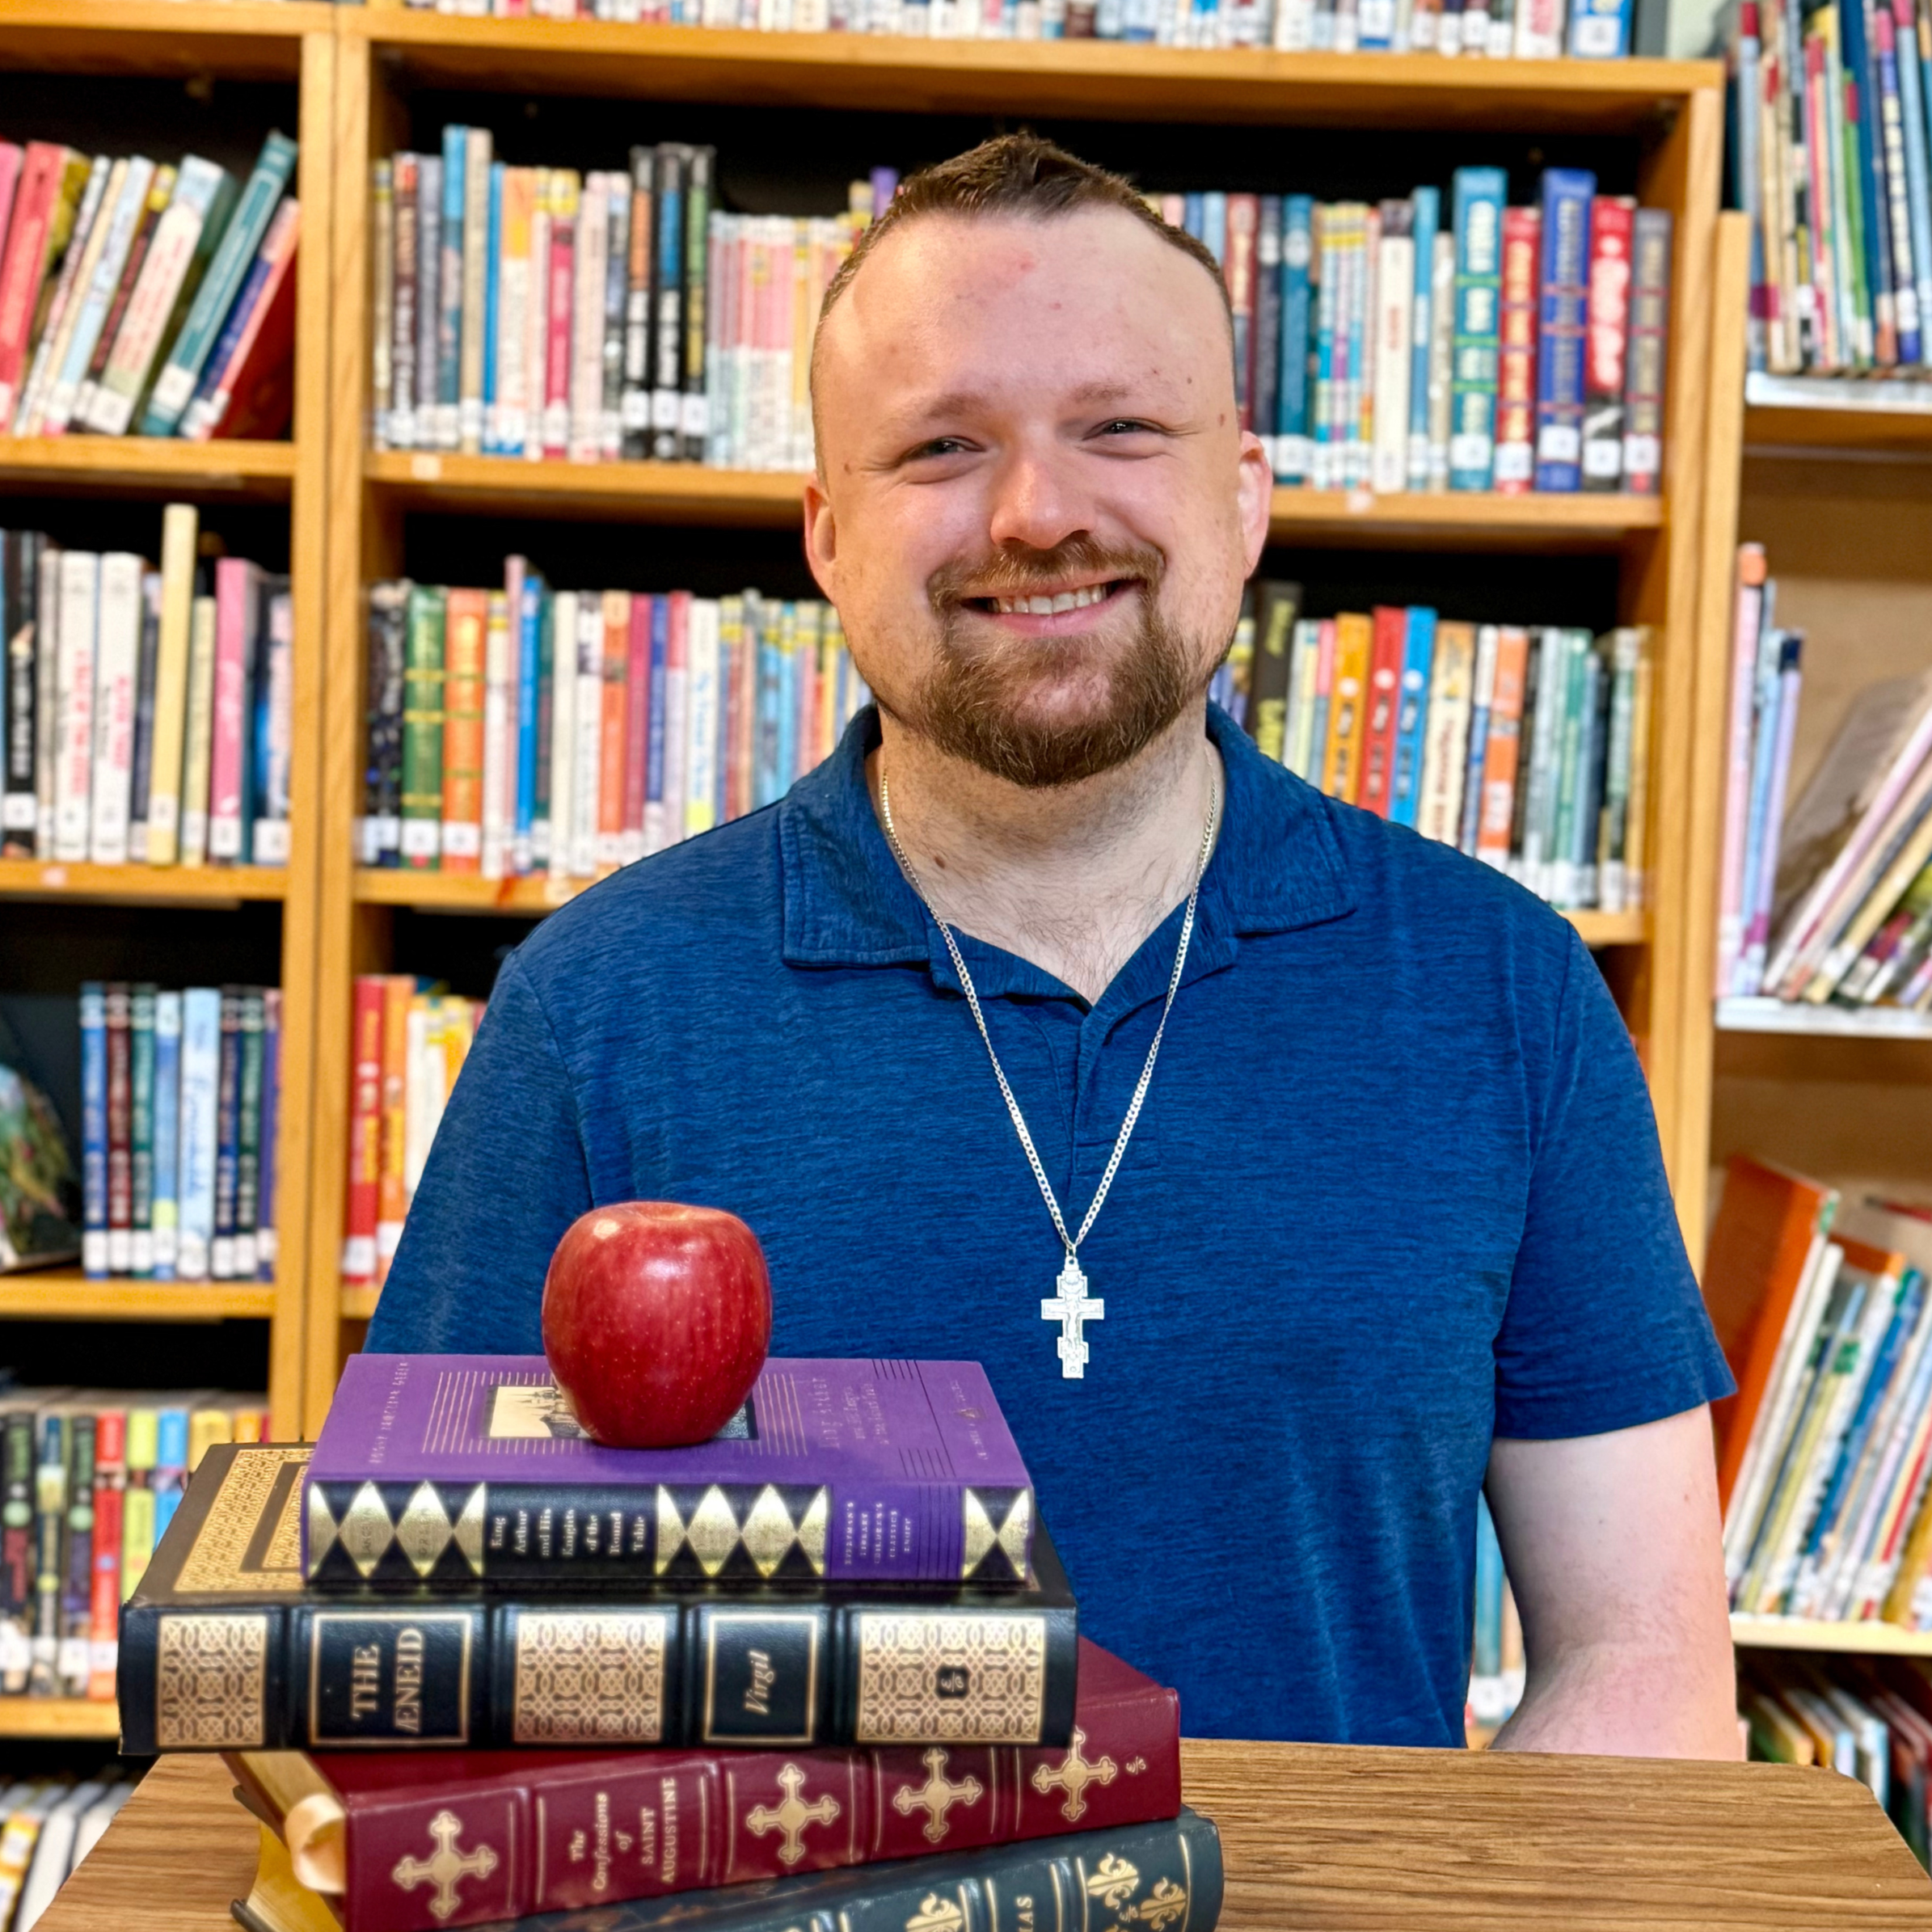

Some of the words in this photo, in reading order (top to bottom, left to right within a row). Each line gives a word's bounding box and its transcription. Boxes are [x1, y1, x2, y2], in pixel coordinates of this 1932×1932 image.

[491, 1517, 506, 1546] King
[515, 1510, 528, 1553] Arthur
[539, 1508, 551, 1530] His
[562, 1508, 576, 1556] Knights
[587, 1515, 598, 1535] the
[610, 1512, 622, 1554] Round
[633, 1516, 644, 1551] Table
[539, 1534, 550, 1556] and
[586, 1538, 597, 1550] of
[352, 1644, 379, 1719] THE
[394, 1628, 423, 1732] ÆNEID
[745, 1651, 774, 1714] Virgil
[571, 1830, 584, 1862] The
[593, 1792, 612, 1890] Confessions
[616, 1831, 632, 1850] of
[641, 1807, 655, 1865] SAINT
[661, 1777, 678, 1883] AUGUSTINE
